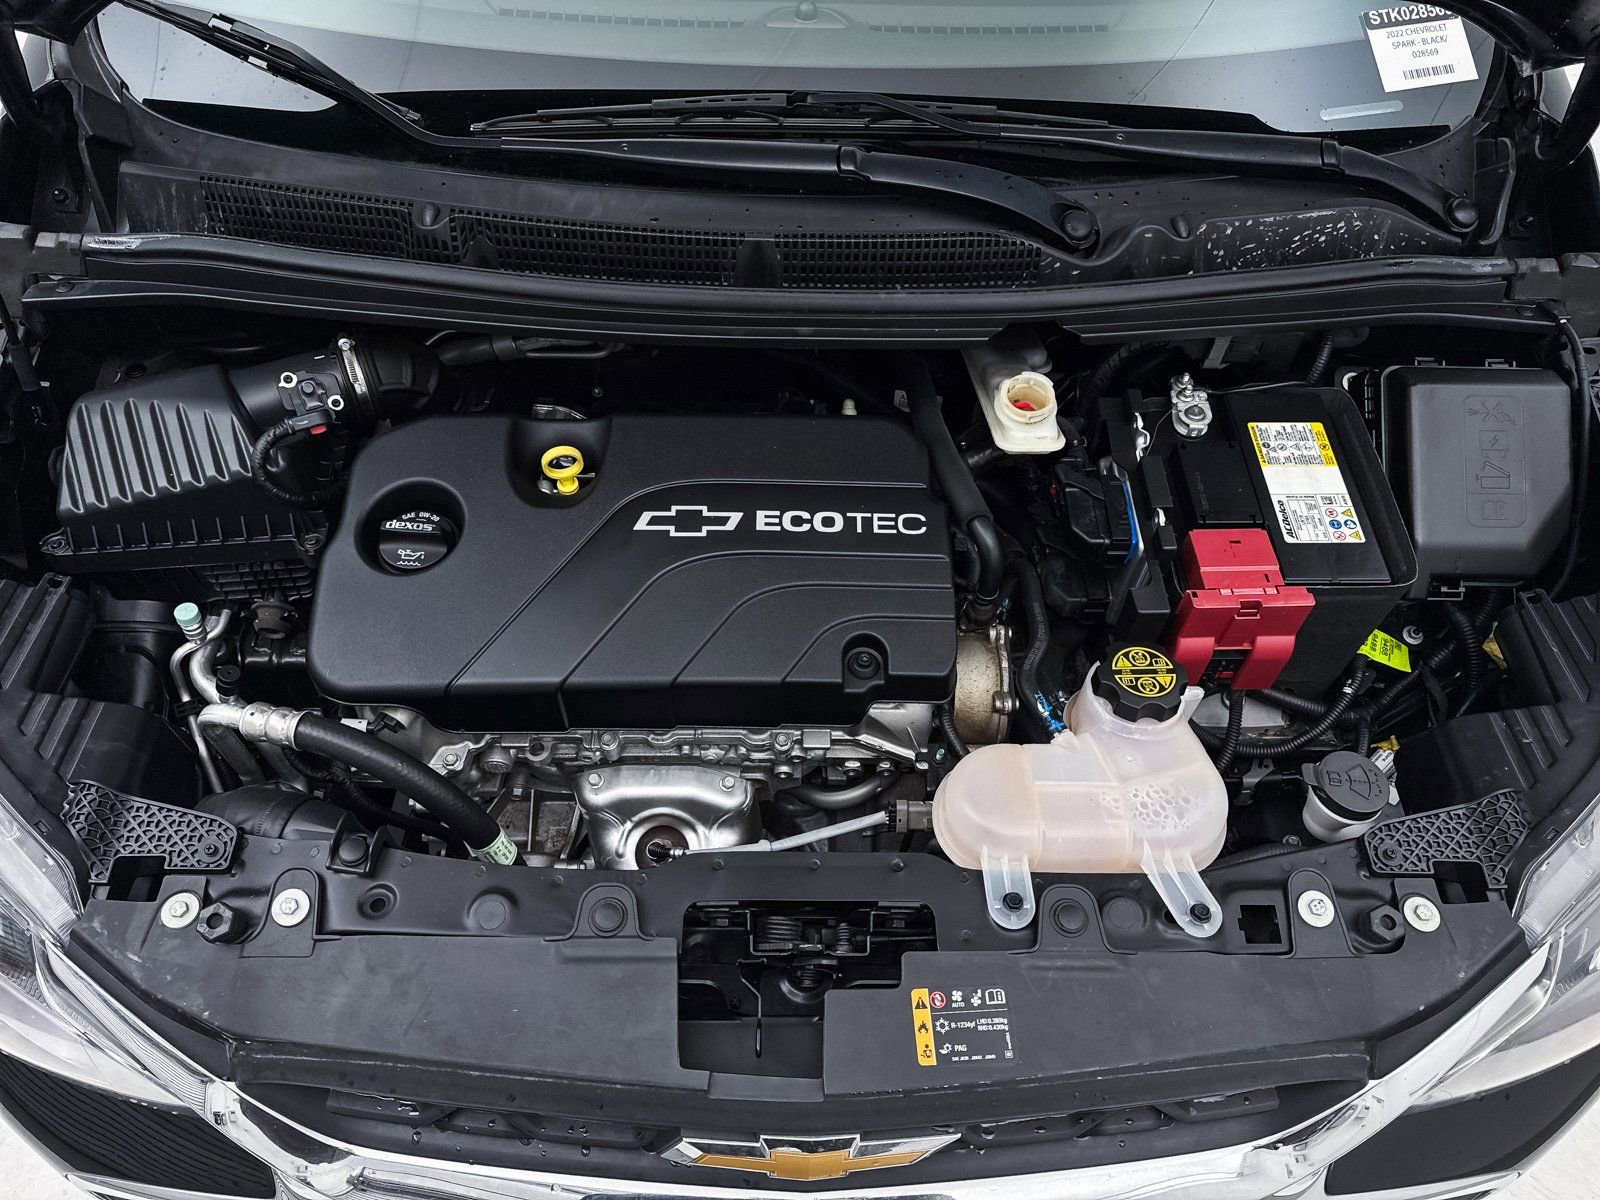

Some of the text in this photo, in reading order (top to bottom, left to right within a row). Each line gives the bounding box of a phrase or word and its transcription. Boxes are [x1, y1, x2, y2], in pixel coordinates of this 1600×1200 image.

[1386, 23, 1447, 39] 2022 CHEVROLET
[1391, 40, 1417, 50] SPARK
[1421, 35, 1448, 46] BLACK/
[1411, 48, 1439, 58] 028569
[402, 511, 440, 522] SAE 0W-20
[756, 510, 927, 535] ECOTEC
[1277, 500, 1297, 539] ACDelco
[385, 519, 433, 531] dexos
[950, 1021, 976, 1029] R-1234yf
[954, 1044, 968, 1052] PAG
